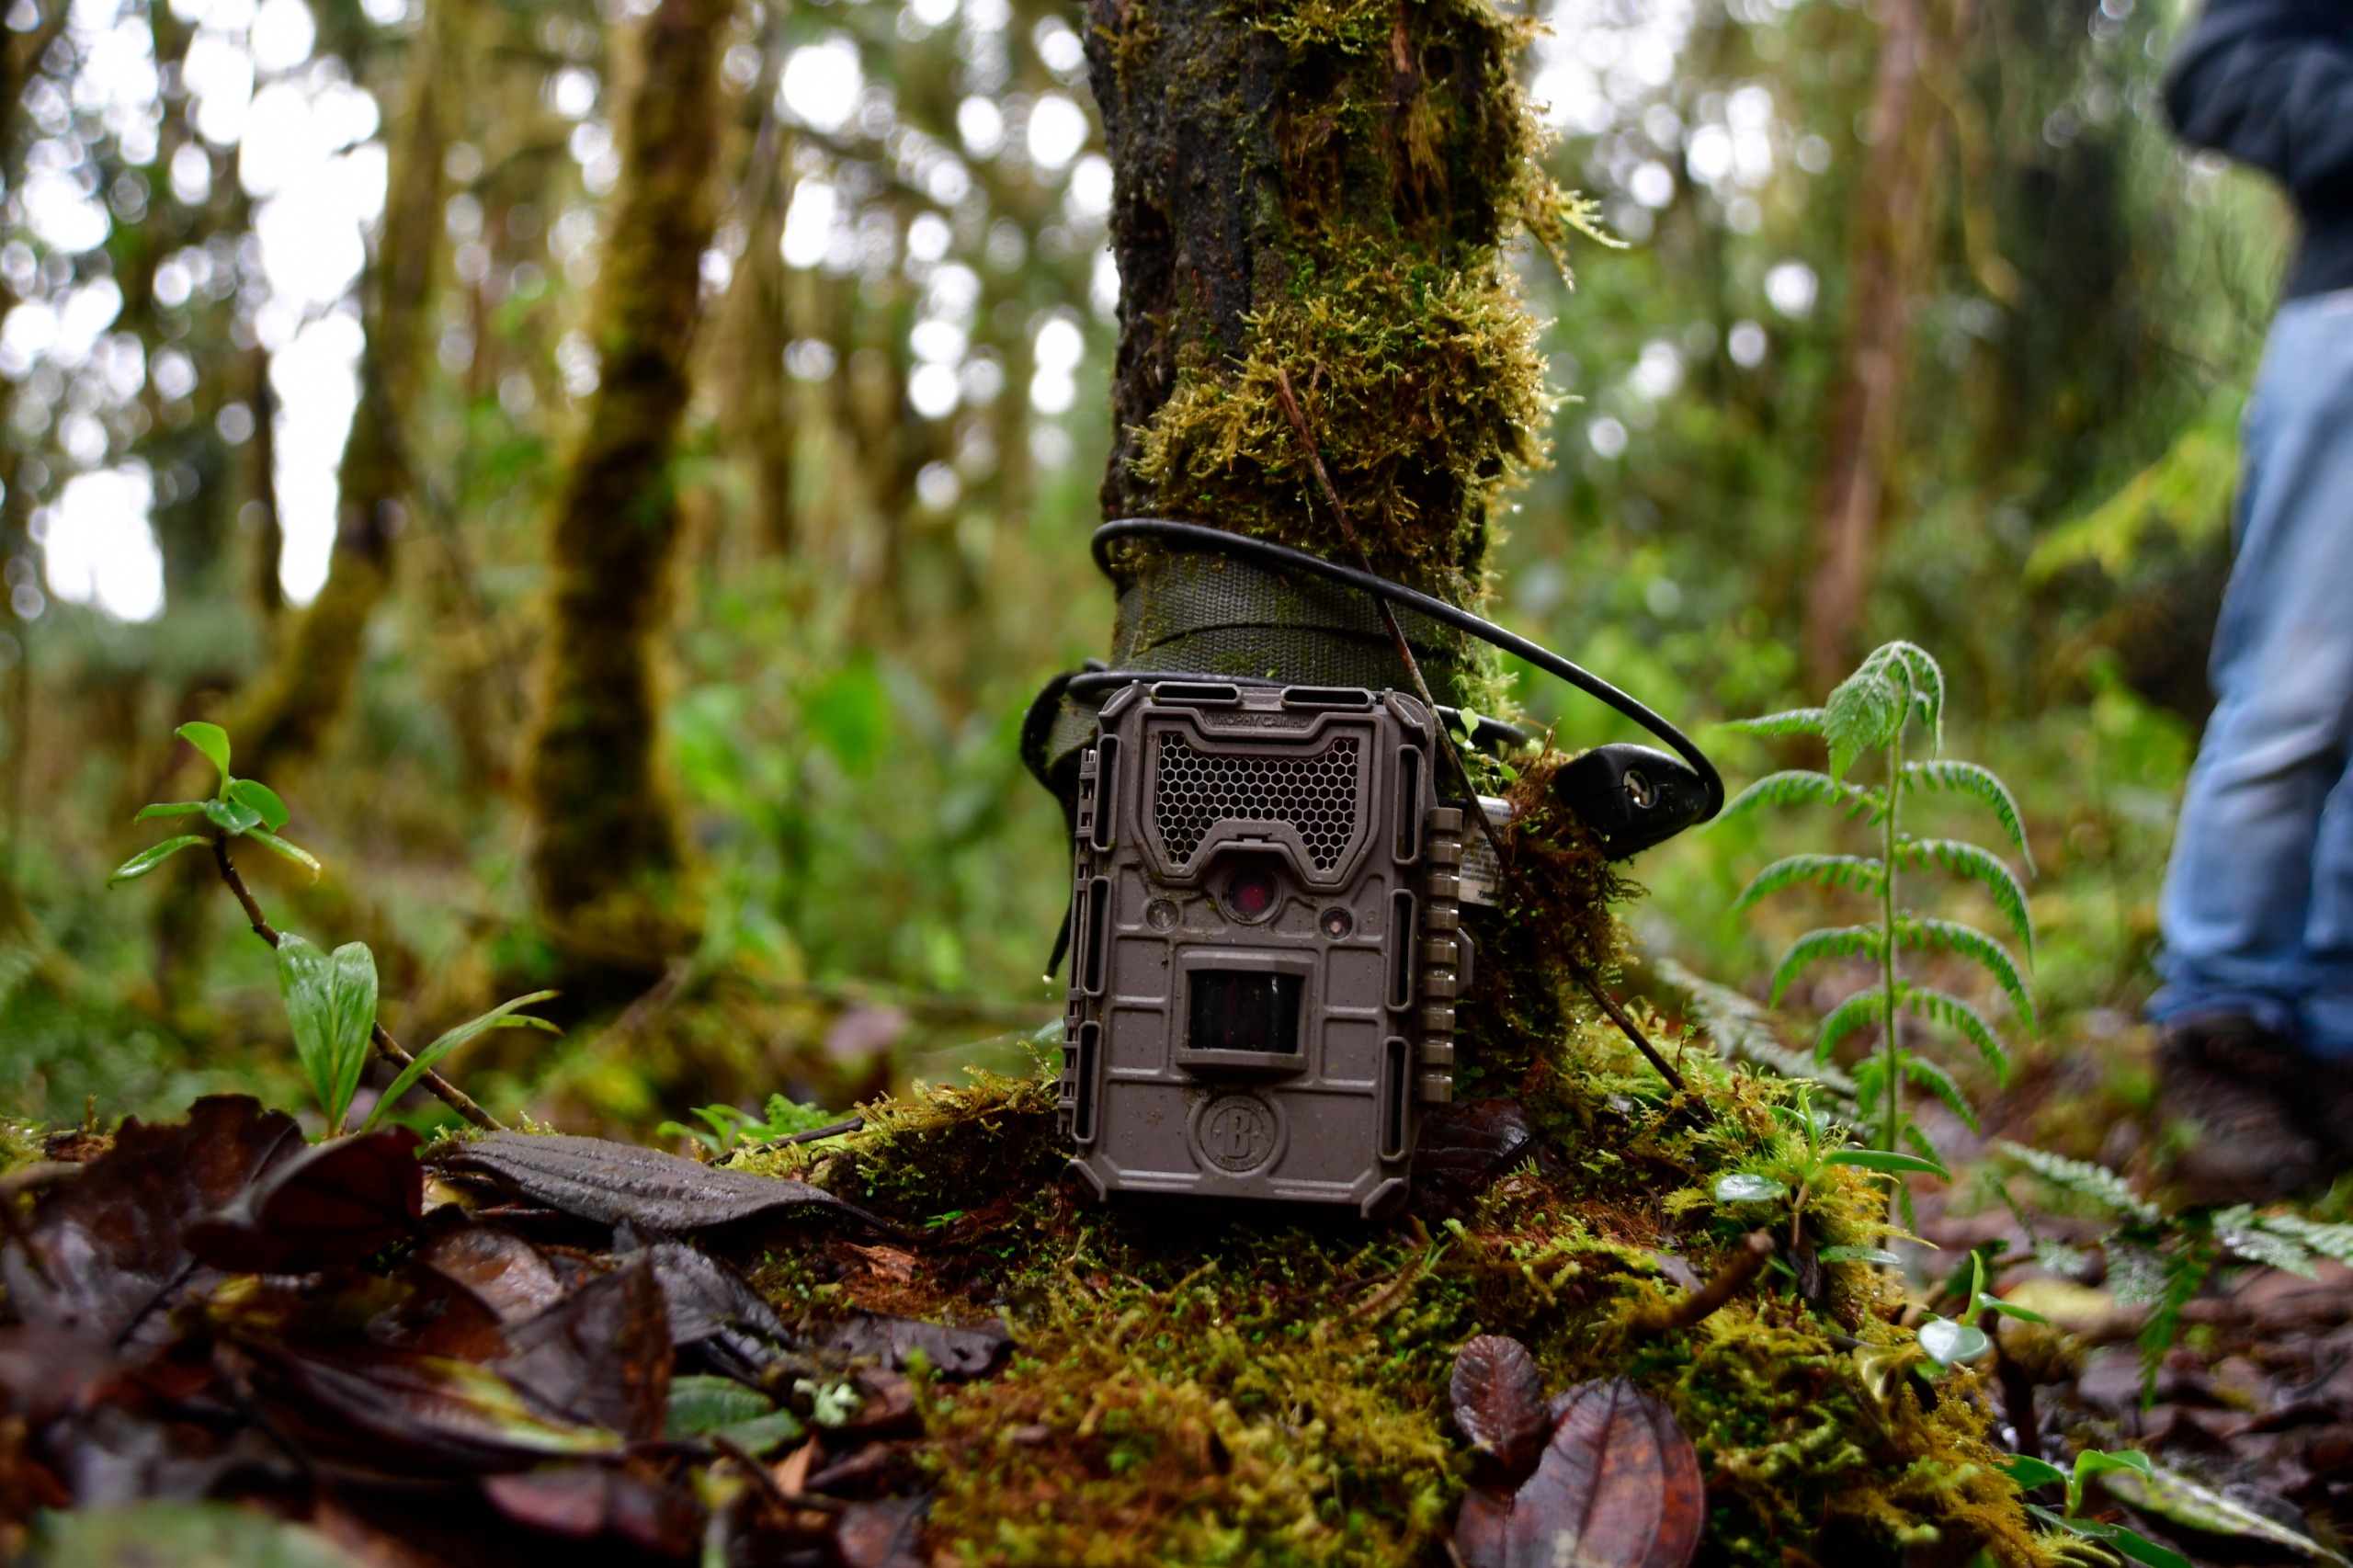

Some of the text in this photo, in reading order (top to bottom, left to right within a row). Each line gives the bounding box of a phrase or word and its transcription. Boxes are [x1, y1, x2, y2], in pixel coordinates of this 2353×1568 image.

[1211, 713, 1310, 728] TROPHY CAM HD
[1224, 1108, 1251, 1159] B
